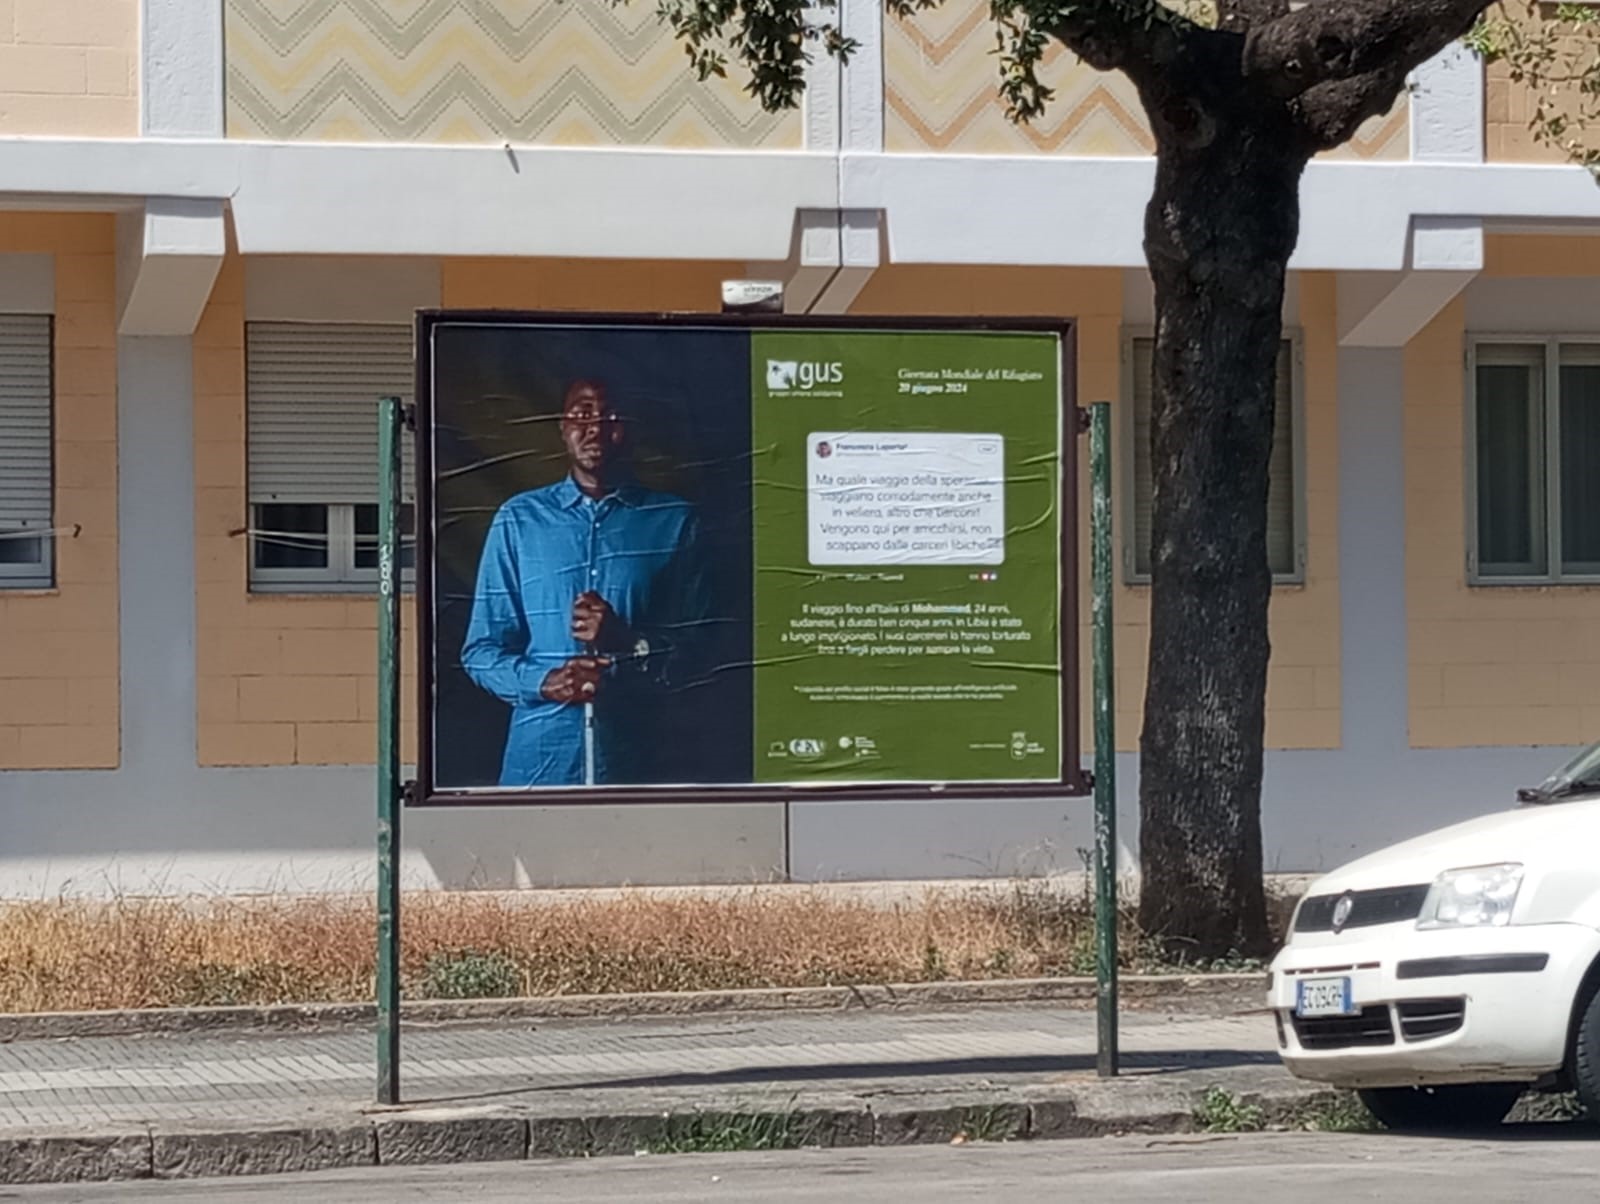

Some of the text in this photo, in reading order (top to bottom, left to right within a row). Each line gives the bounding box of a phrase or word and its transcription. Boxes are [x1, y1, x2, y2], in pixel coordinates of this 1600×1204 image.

[799, 362, 843, 389] gus
[911, 383, 943, 395] giugno
[816, 474, 833, 485] Ma
[912, 473, 937, 485] della
[819, 523, 870, 536] Vengono
[893, 524, 911, 537] per
[970, 525, 992, 535] non
[826, 540, 880, 552] scappano
